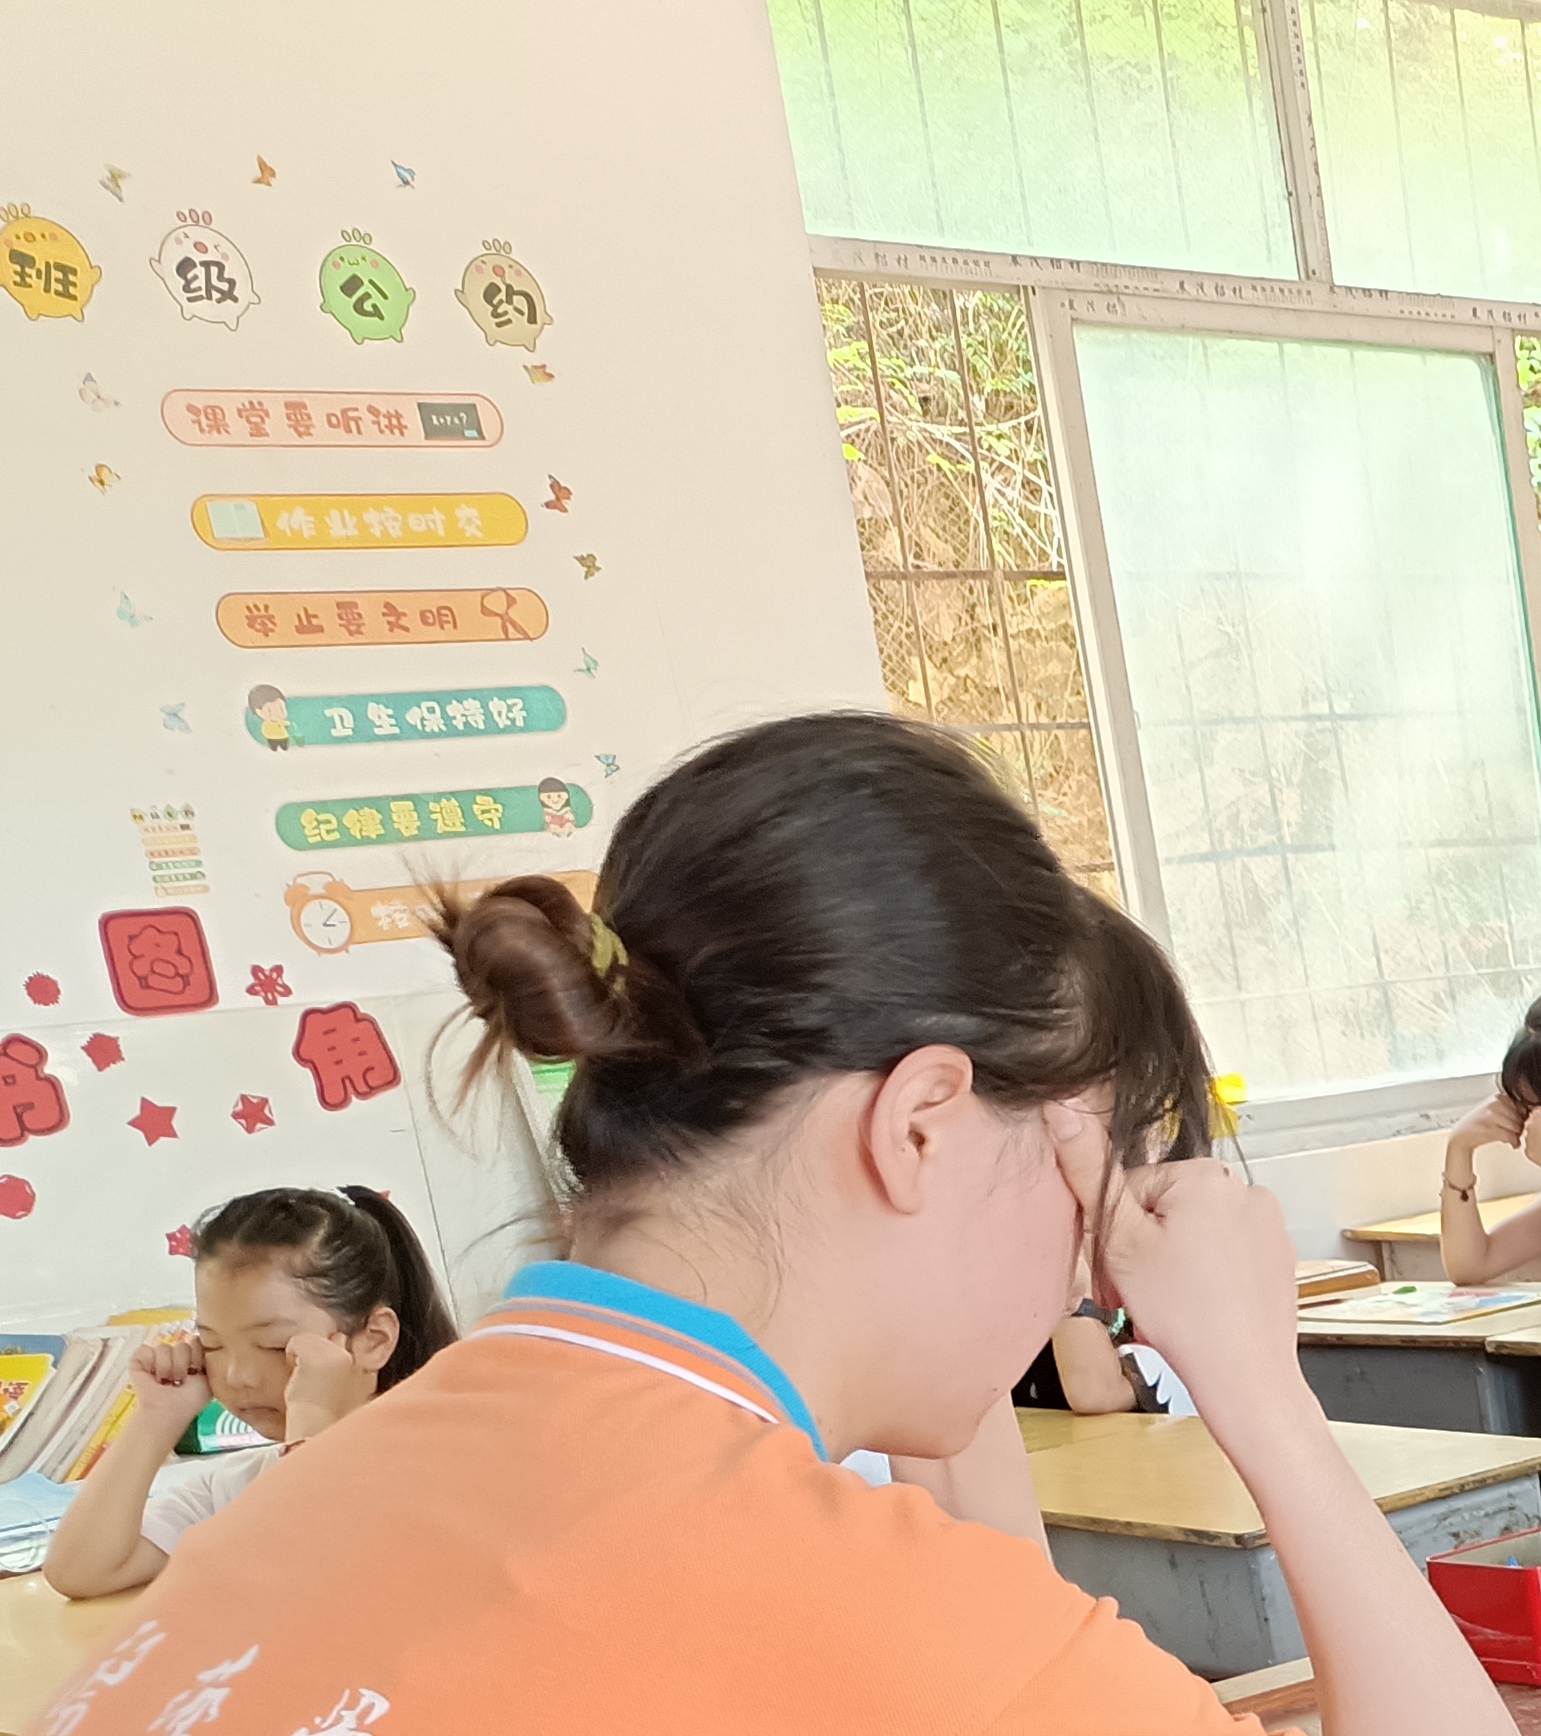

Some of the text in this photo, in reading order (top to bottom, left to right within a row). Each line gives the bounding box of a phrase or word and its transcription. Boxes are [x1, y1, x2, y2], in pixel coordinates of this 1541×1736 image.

[185, 400, 410, 438] 课堂要听讲
[275, 503, 485, 540] 作业按时交
[243, 601, 459, 637] 举止要文明
[324, 697, 528, 738] 卫生保持好
[300, 795, 506, 844] 纪律要遵守
